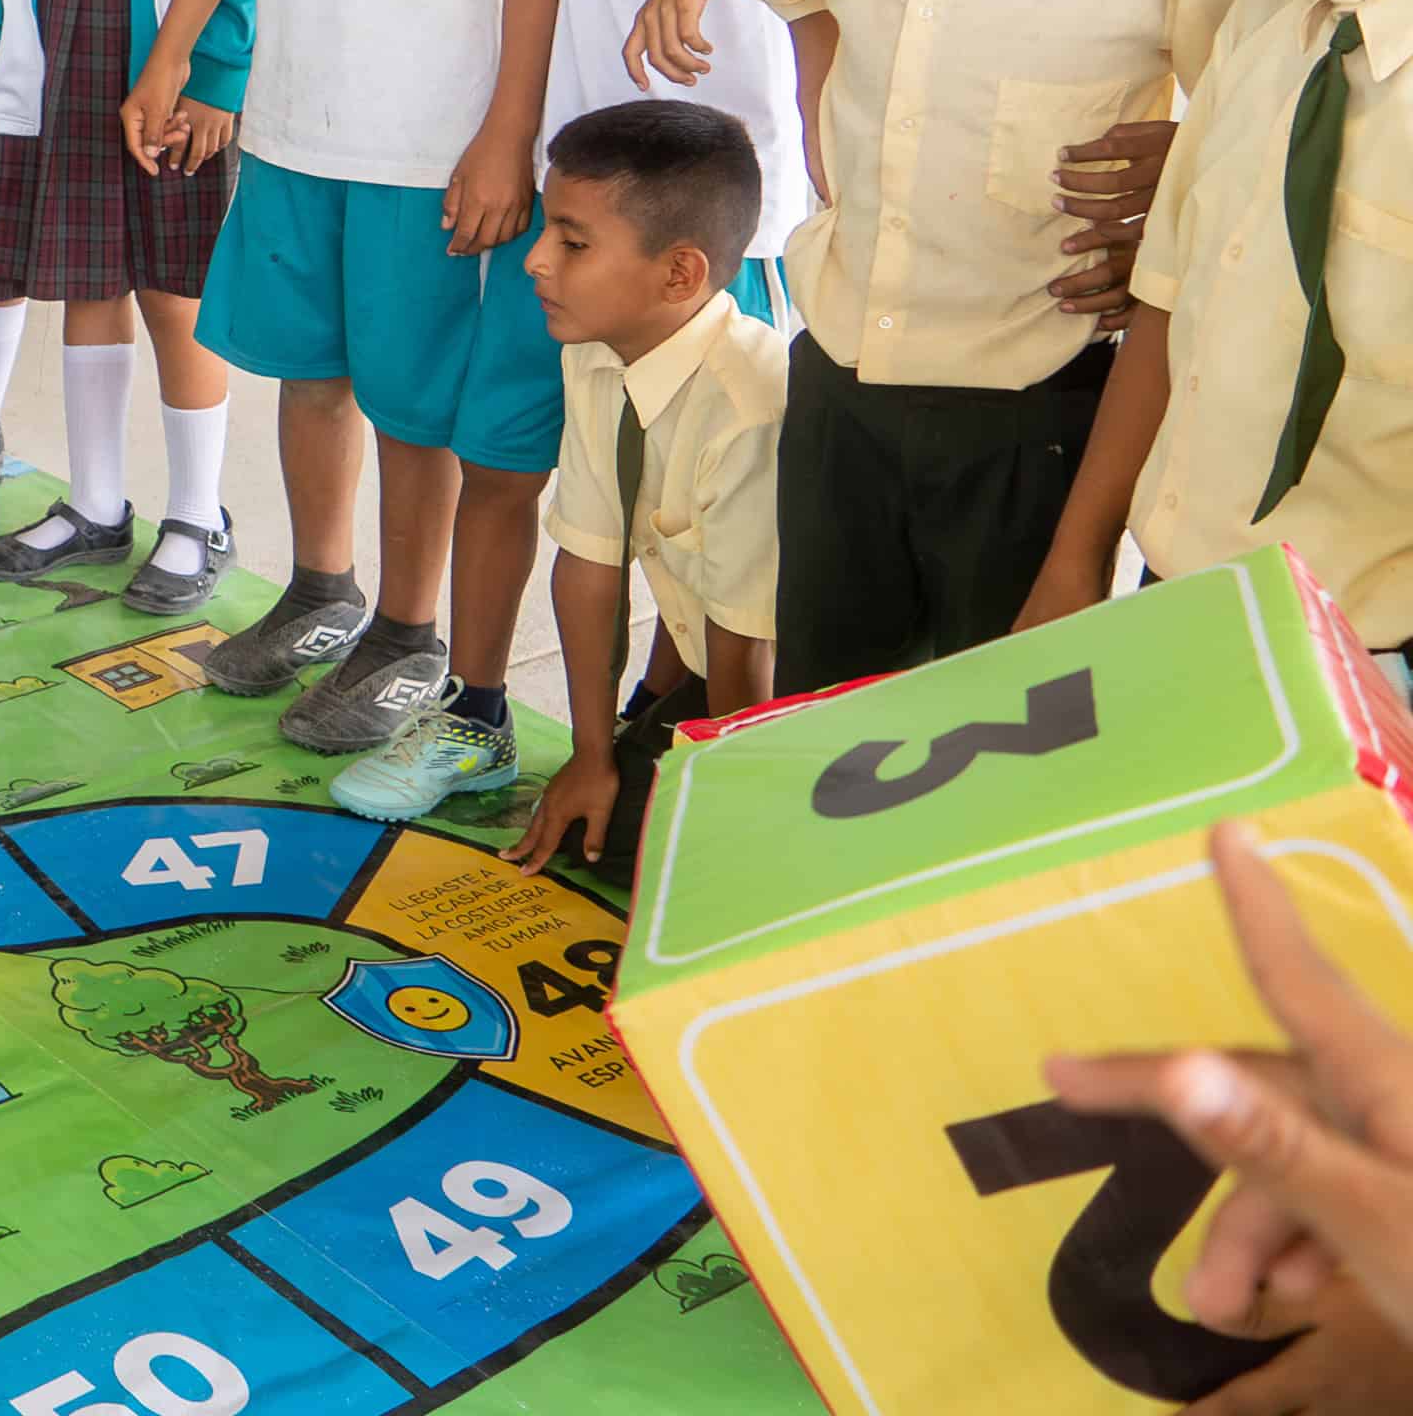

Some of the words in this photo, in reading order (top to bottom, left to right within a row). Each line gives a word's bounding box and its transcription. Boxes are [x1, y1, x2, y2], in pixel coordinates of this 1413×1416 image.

[811, 666, 1100, 819] 3
[120, 828, 271, 891] 47
[388, 871, 474, 912] LLEGASTE
[478, 867, 498, 881] A
[406, 909, 432, 924] LA
[435, 890, 486, 915] CASA
[486, 878, 514, 894] DE
[415, 925, 443, 941] LA
[444, 884, 553, 931] COSTURERA
[462, 914, 520, 942] AMIGA
[522, 903, 552, 919] DE
[482, 938, 513, 954] TU
[548, 1032, 621, 1072] AVAN
[578, 1056, 636, 1089] ESP
[388, 1160, 575, 1282] 49
